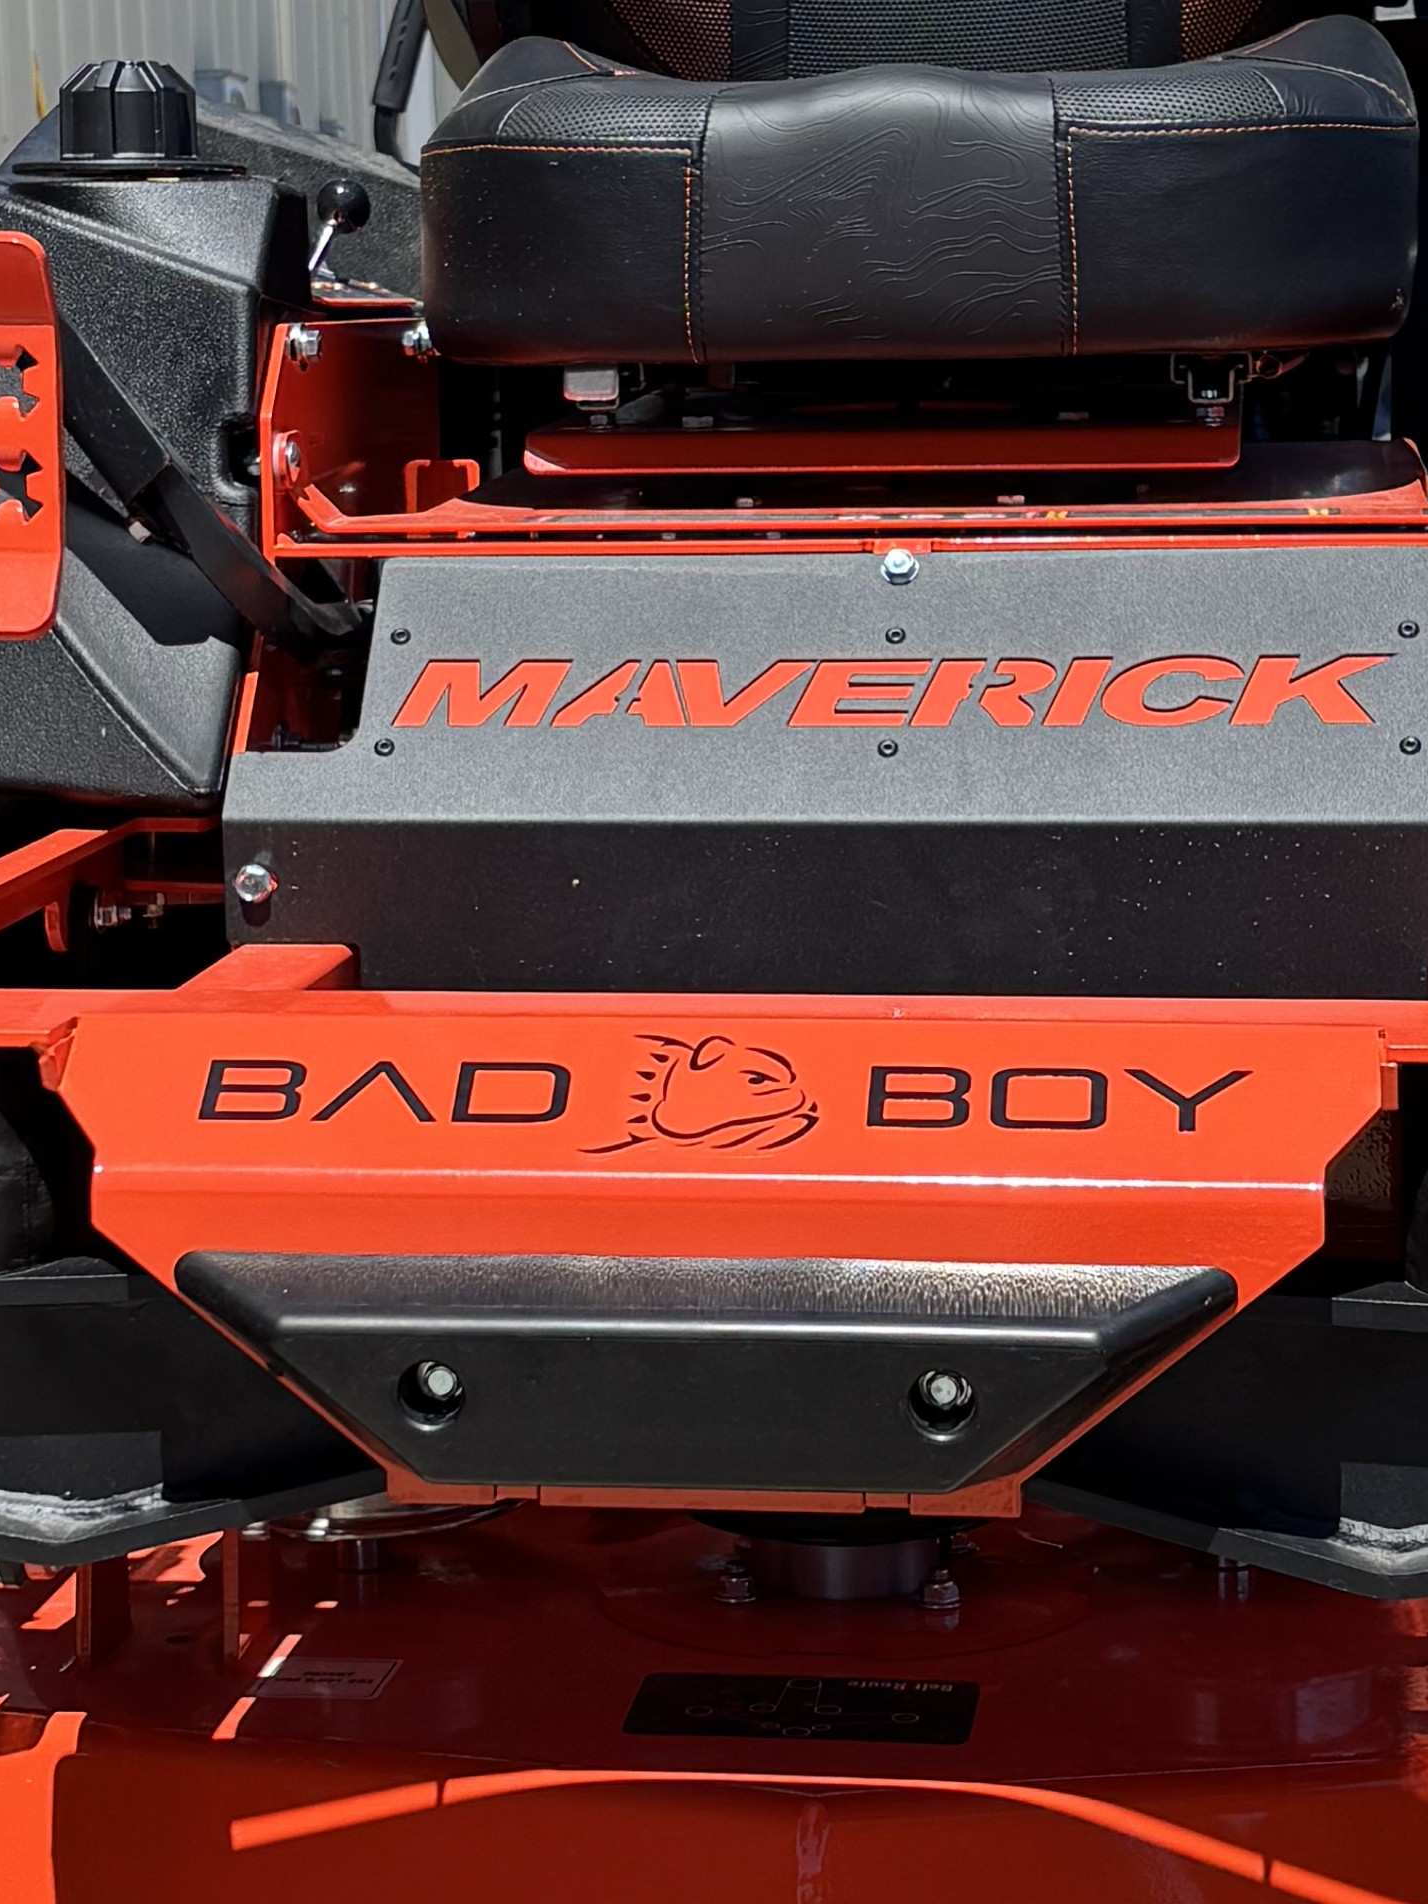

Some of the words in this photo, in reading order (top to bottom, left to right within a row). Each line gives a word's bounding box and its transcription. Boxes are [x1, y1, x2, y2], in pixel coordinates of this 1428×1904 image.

[390, 651, 1401, 729] MAVERICK
[197, 1057, 573, 1125] BAD
[865, 1064, 1254, 1135] BOY
